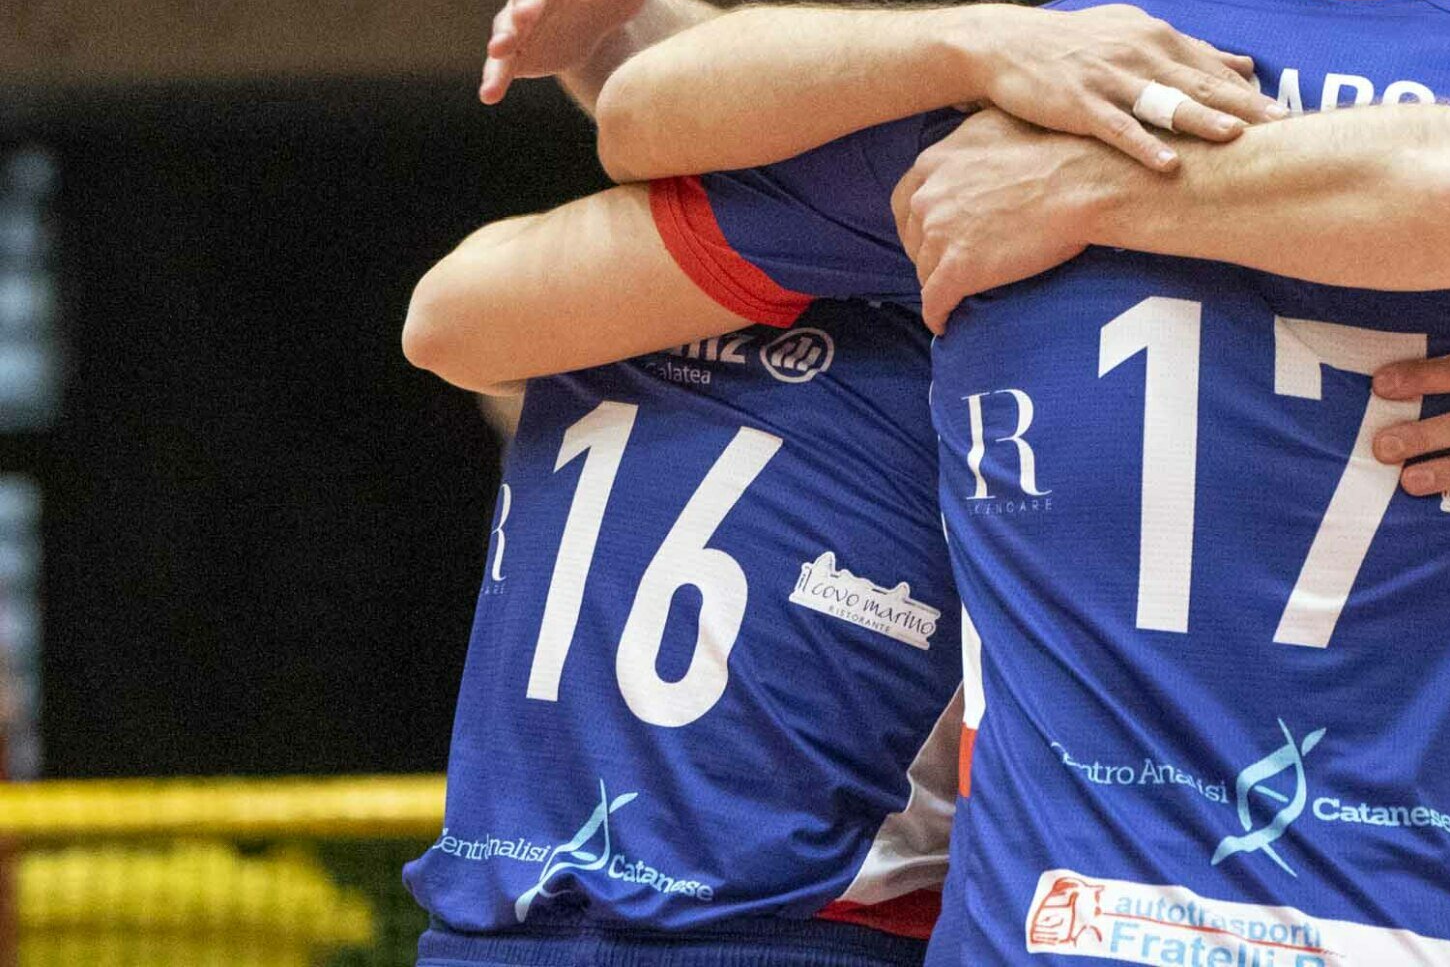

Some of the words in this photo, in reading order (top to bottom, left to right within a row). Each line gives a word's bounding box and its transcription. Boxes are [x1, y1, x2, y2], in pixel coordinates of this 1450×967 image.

[645, 360, 712, 385] alatea
[961, 388, 1053, 500] R
[1099, 296, 1427, 648] 17
[527, 400, 783, 727] 16
[811, 582, 860, 608] covo
[863, 598, 936, 635] marino
